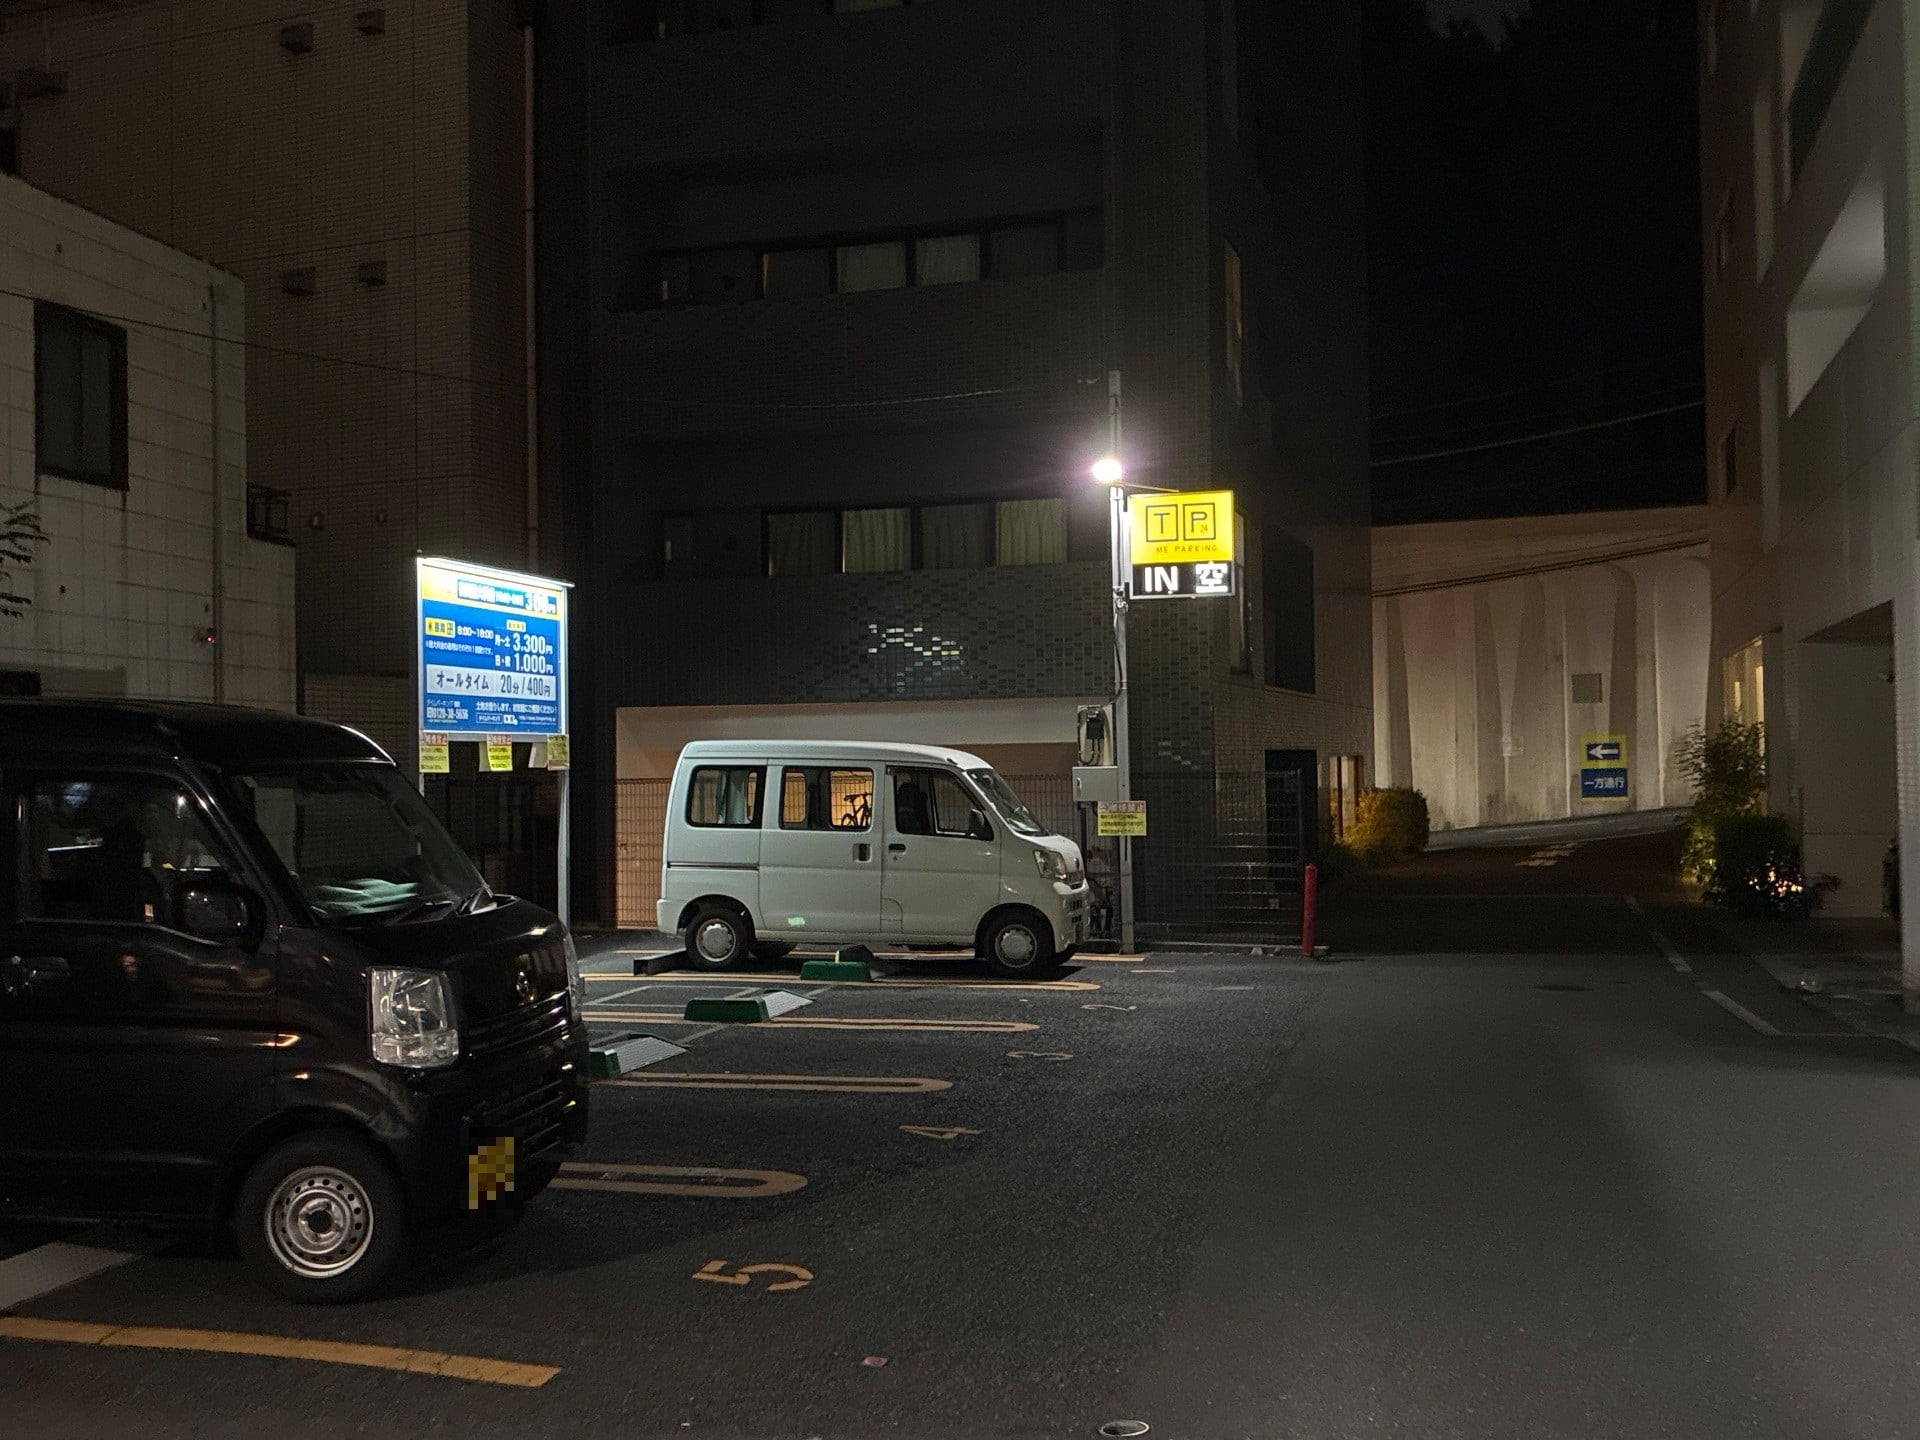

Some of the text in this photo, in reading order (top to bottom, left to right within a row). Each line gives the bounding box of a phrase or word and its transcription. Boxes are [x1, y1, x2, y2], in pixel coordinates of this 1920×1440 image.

[1175, 545, 1217, 553] PARKING
[1144, 566, 1178, 592] IN
[1195, 561, 1229, 593] 空
[436, 670, 489, 690] オールタイム
[1583, 777, 1625, 789] 一方通行
[1006, 1049, 1074, 1062] 3
[900, 1124, 989, 1141] 4
[692, 1260, 815, 1292] 5
